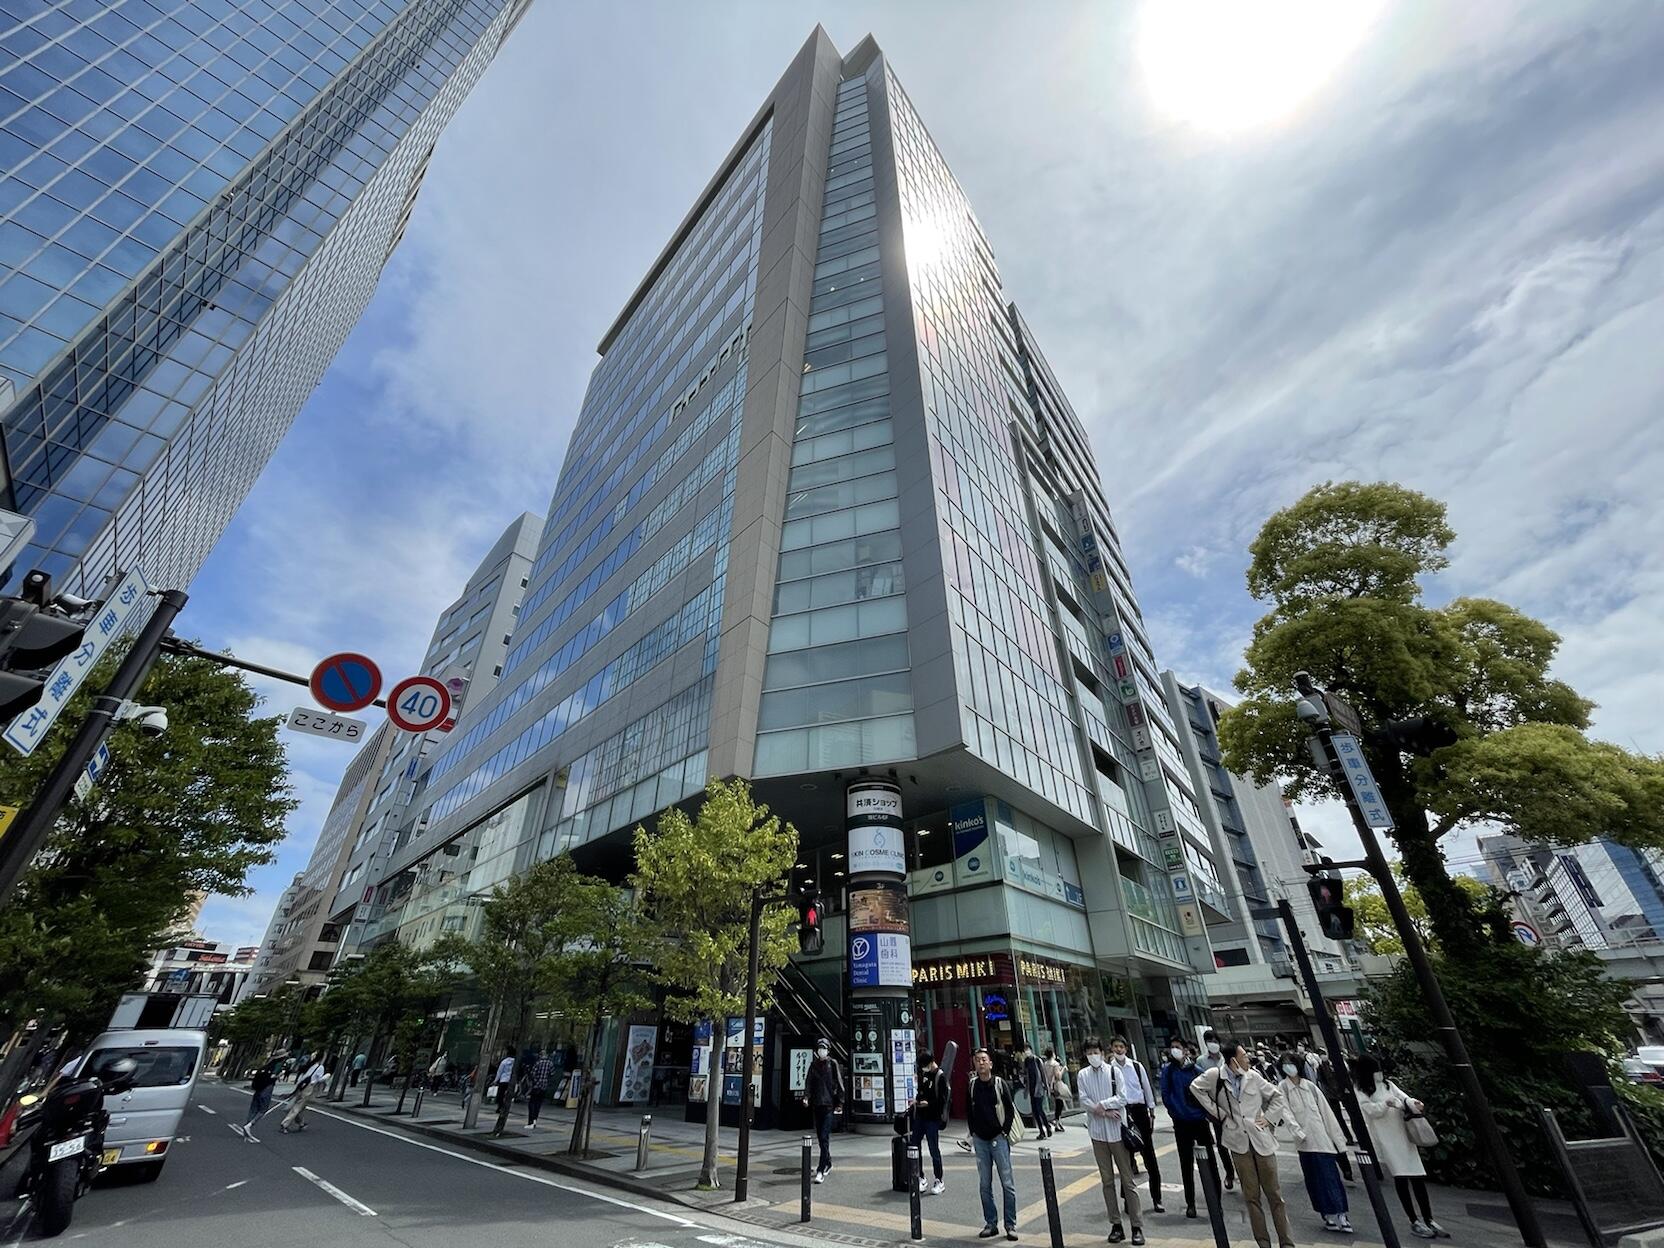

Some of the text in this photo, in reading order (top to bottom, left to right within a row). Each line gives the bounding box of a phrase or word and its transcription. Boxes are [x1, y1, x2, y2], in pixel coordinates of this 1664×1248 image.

[20, 582, 138, 738] 歩車分離式
[400, 690, 438, 719] 40
[294, 713, 359, 738] ここから
[1339, 741, 1385, 822] 歩車分離式
[954, 815, 985, 831] kinko's
[912, 964, 953, 983] PARIS
[956, 960, 995, 979] MIKI
[1020, 960, 1045, 979] PARIS
